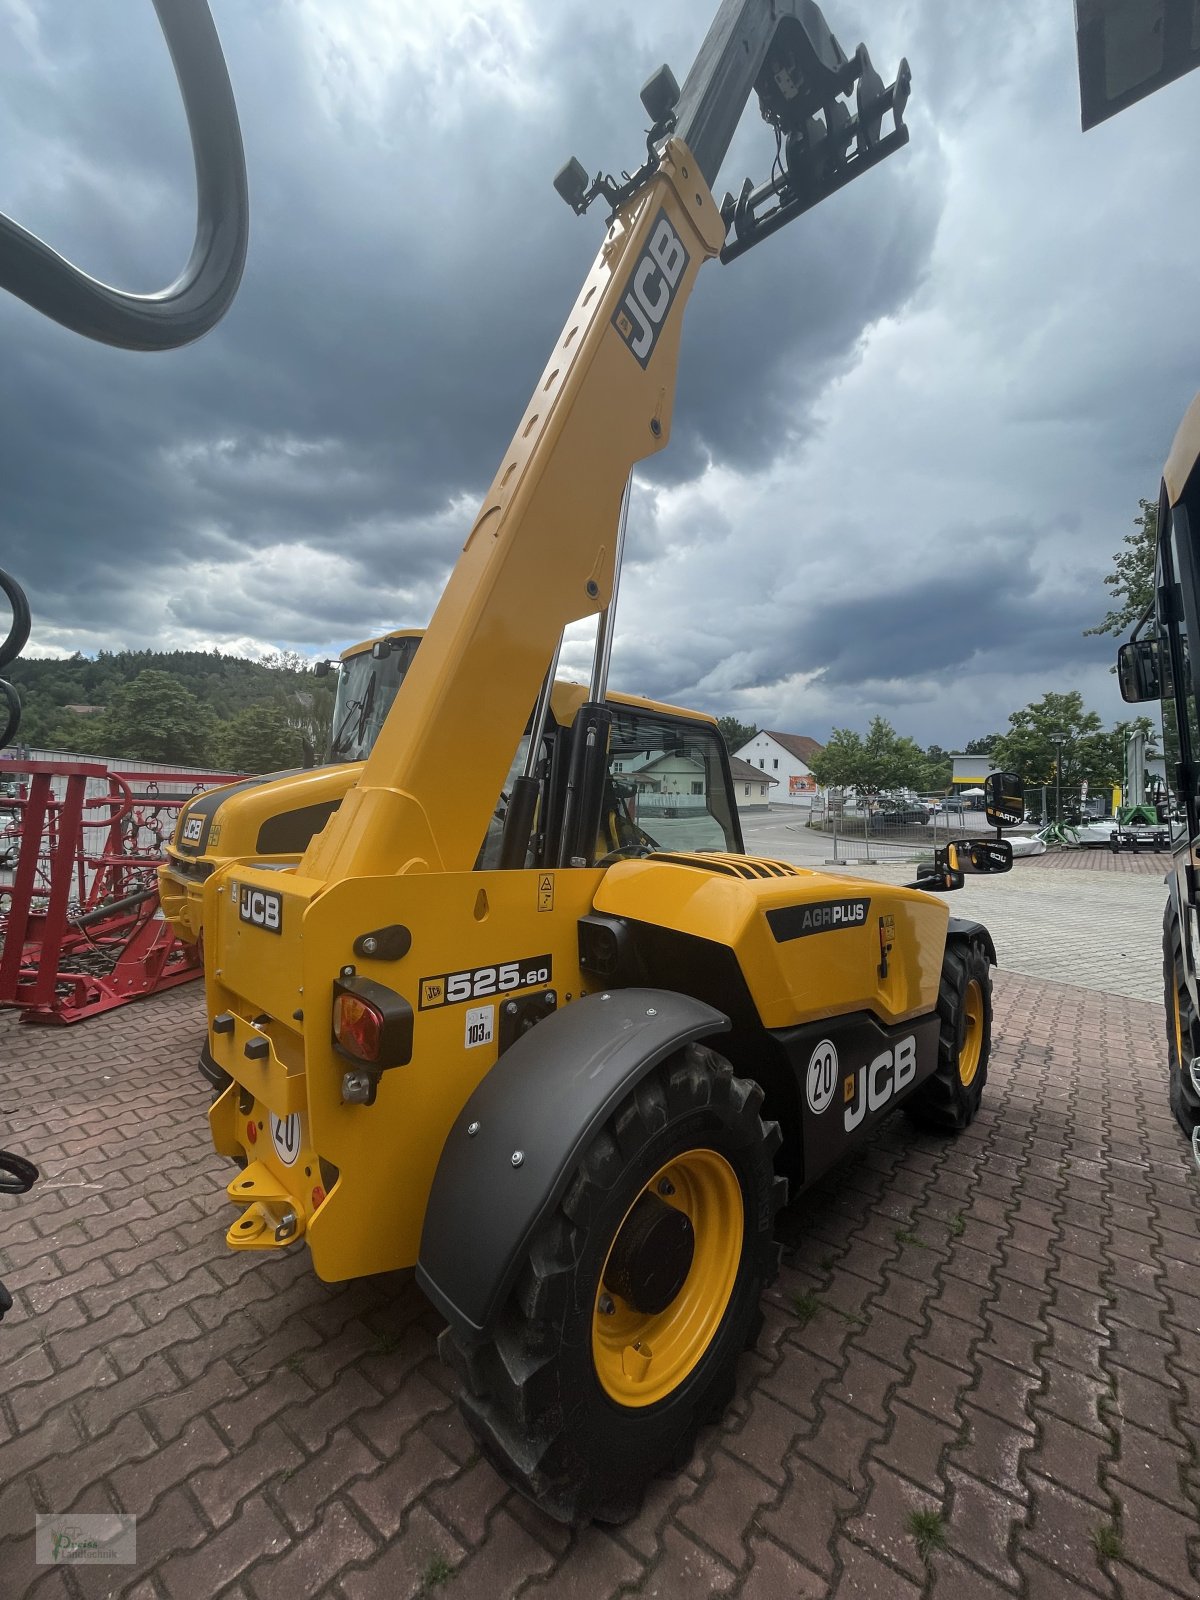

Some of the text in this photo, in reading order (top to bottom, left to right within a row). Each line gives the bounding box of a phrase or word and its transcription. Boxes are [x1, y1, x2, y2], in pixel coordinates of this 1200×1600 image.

[625, 219, 685, 359] JCB
[184, 819, 202, 840] JCB
[241, 890, 280, 928] JCB
[427, 985, 441, 1000] JCB
[468, 1023, 485, 1044] 103
[814, 1053, 832, 1102] 20
[844, 1035, 916, 1132] JCB
